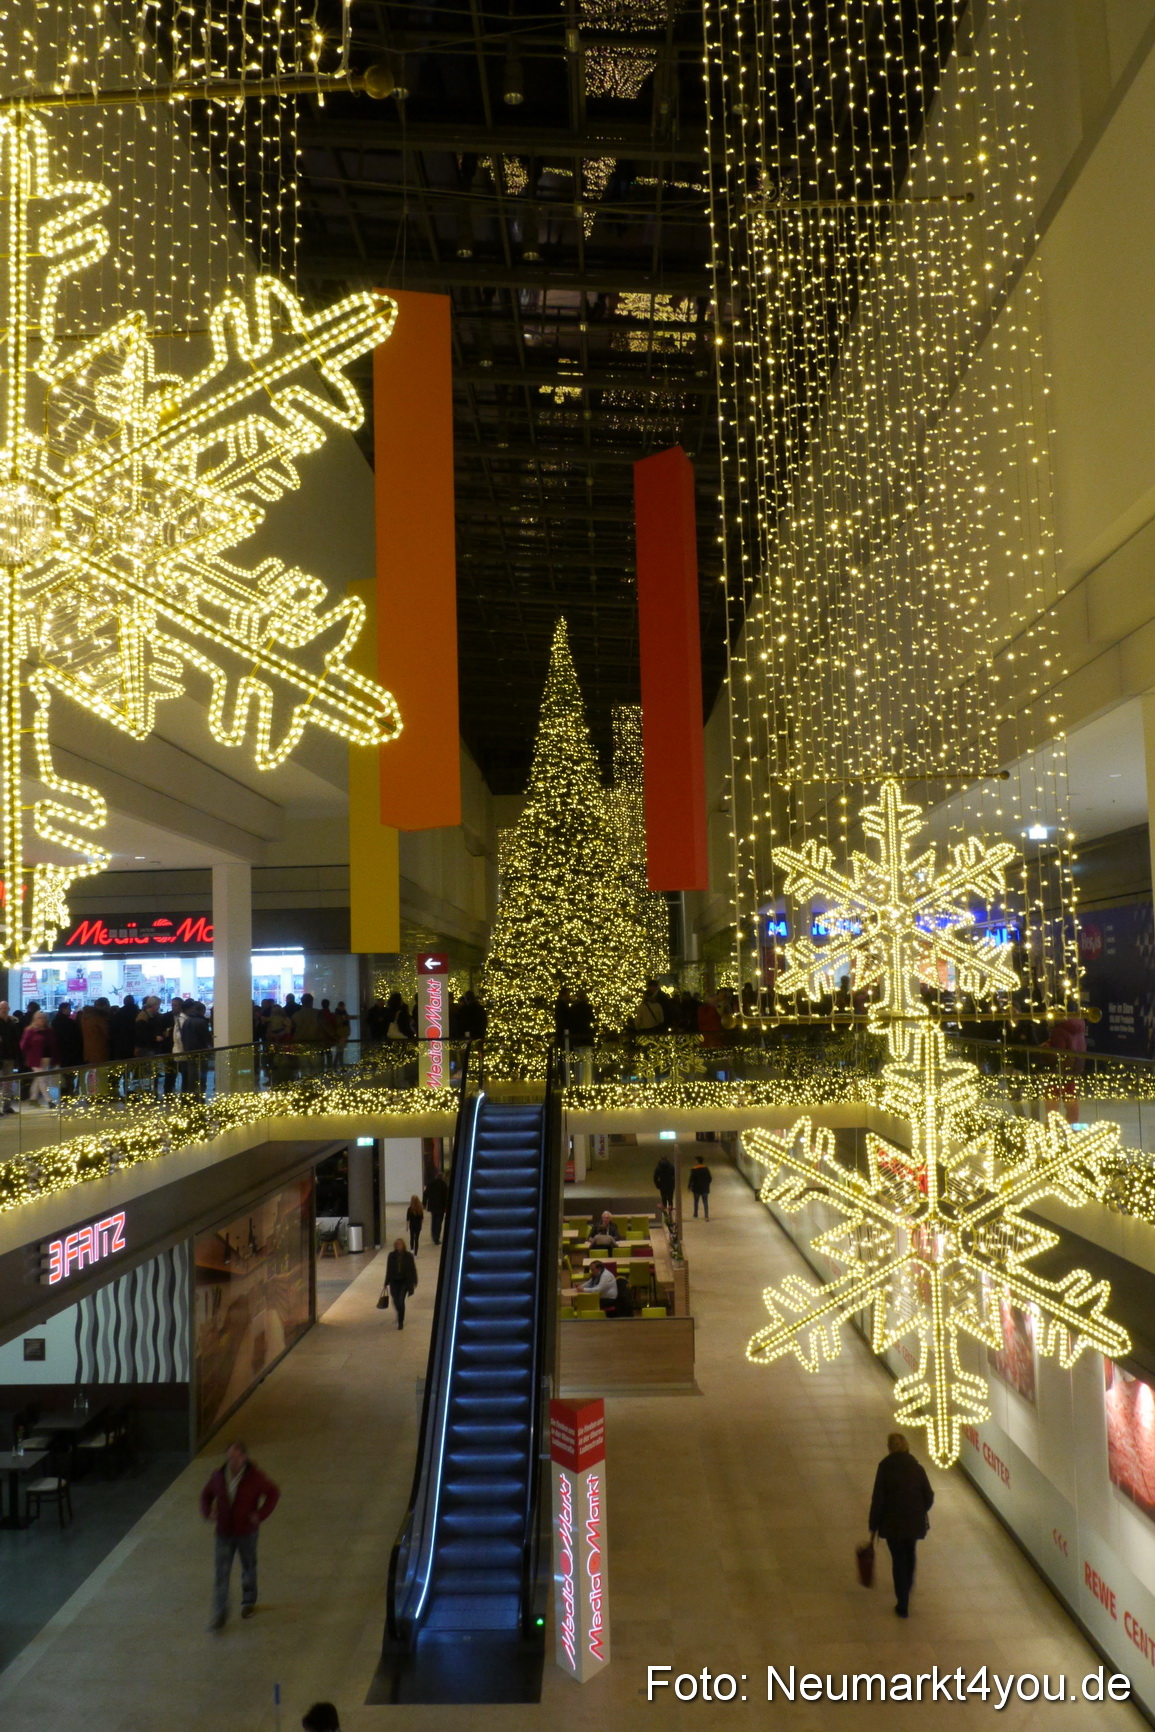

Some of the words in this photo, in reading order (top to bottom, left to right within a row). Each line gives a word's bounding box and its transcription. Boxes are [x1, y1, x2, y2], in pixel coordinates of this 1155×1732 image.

[425, 978, 442, 1029] Markt
[426, 1040, 443, 1091] Media
[557, 1473, 573, 1546] Markt
[586, 1473, 602, 1552] Markt
[561, 1574, 576, 1671] Media
[588, 1573, 605, 1662] Media
[1084, 1561, 1118, 1622] REWE
